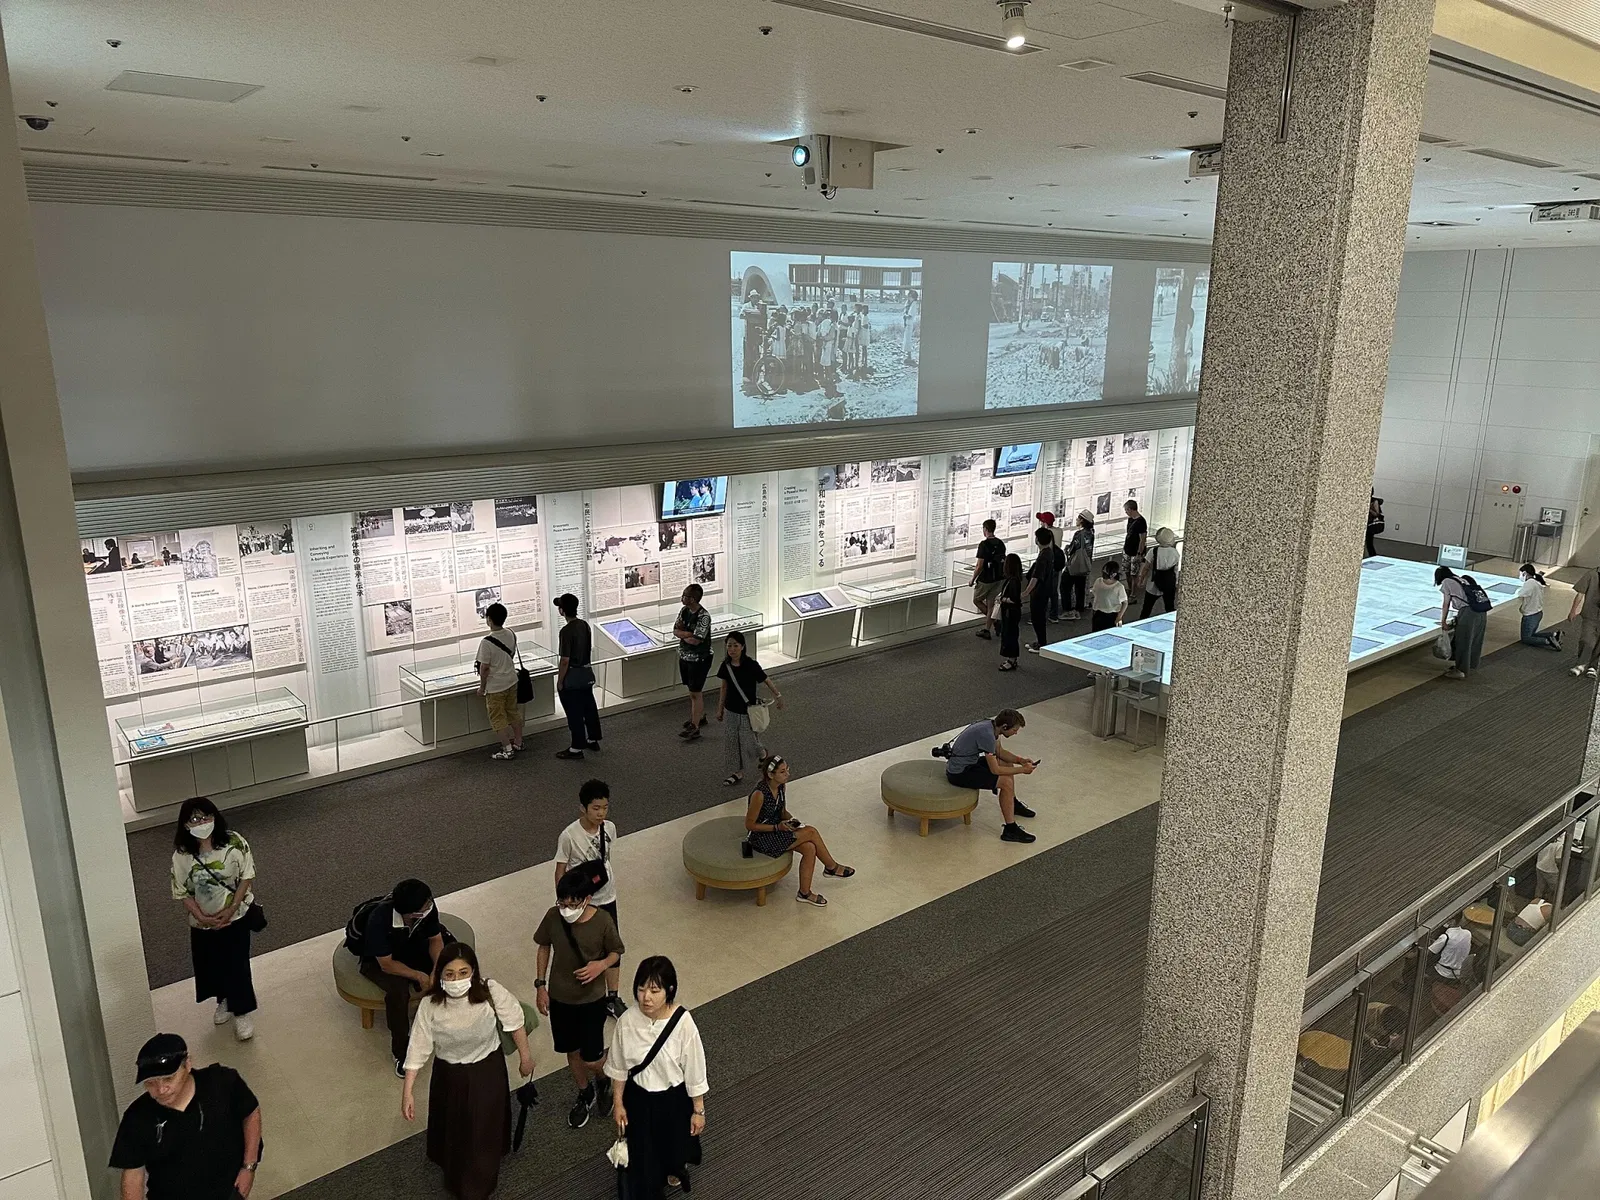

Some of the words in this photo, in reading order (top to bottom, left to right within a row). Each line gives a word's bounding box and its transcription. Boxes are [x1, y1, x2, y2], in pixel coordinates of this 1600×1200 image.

[350, 527, 364, 597] 被爆体験の継承・伝承
[584, 503, 592, 561] 市民による平和運動
